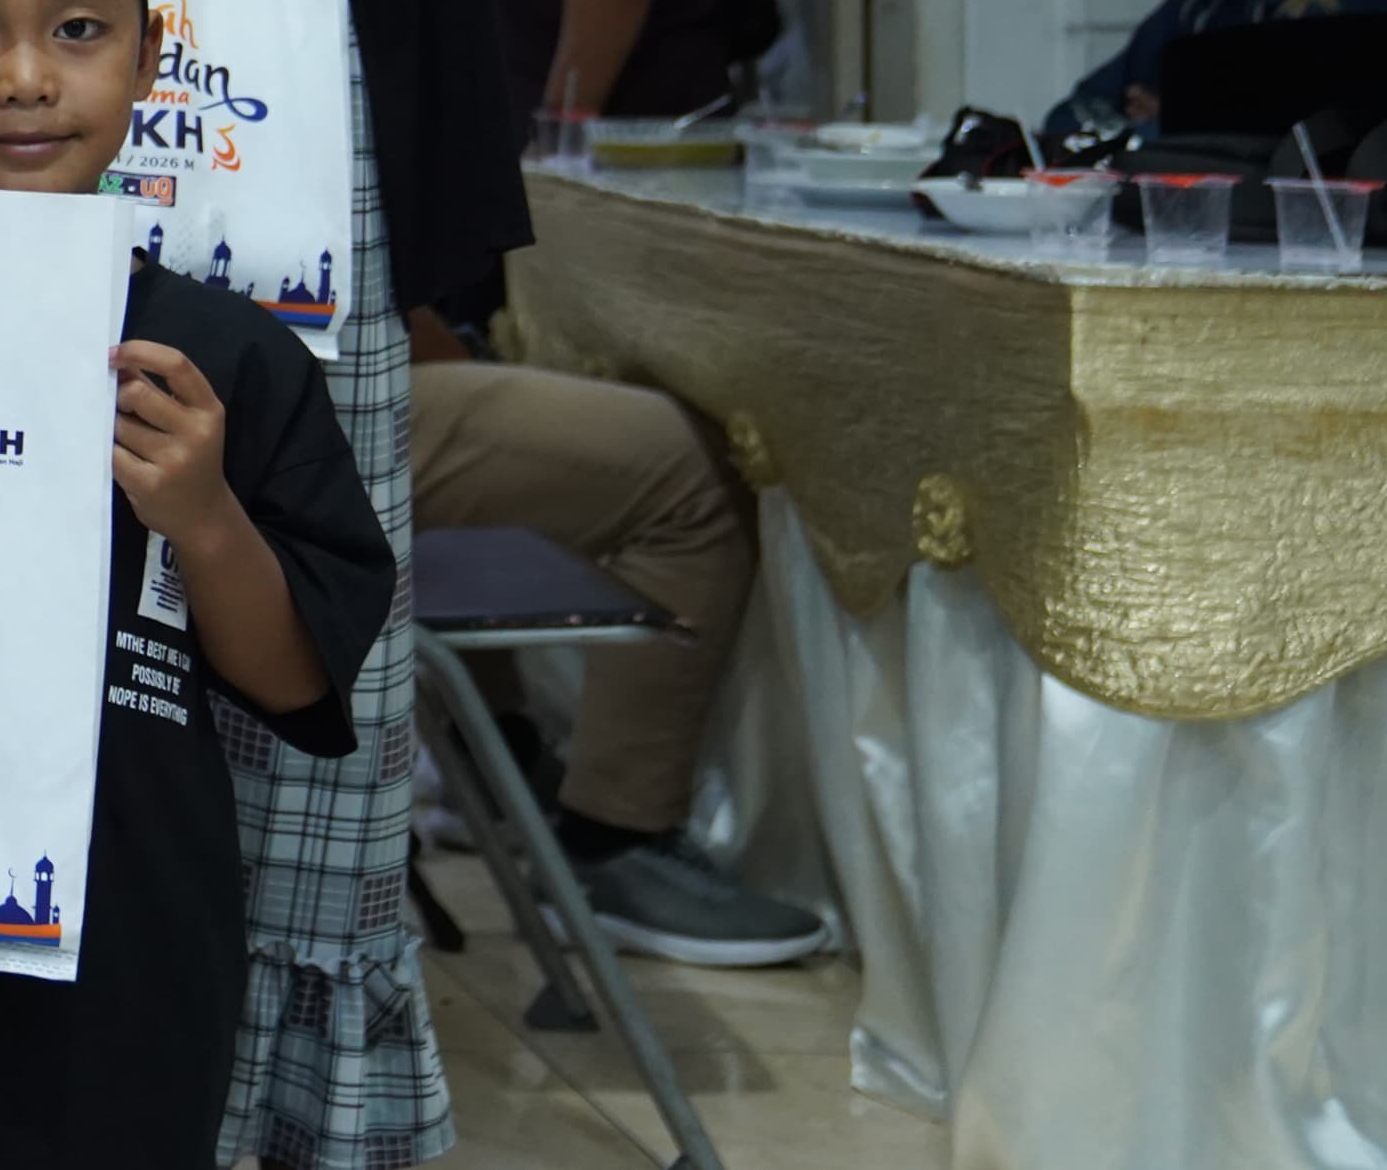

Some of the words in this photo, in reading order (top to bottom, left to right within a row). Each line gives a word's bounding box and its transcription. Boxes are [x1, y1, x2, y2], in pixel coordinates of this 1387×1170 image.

[132, 109, 204, 153] KH
[139, 155, 179, 169] 2026
[184, 159, 195, 171] M
[138, 693, 150, 712] IS
